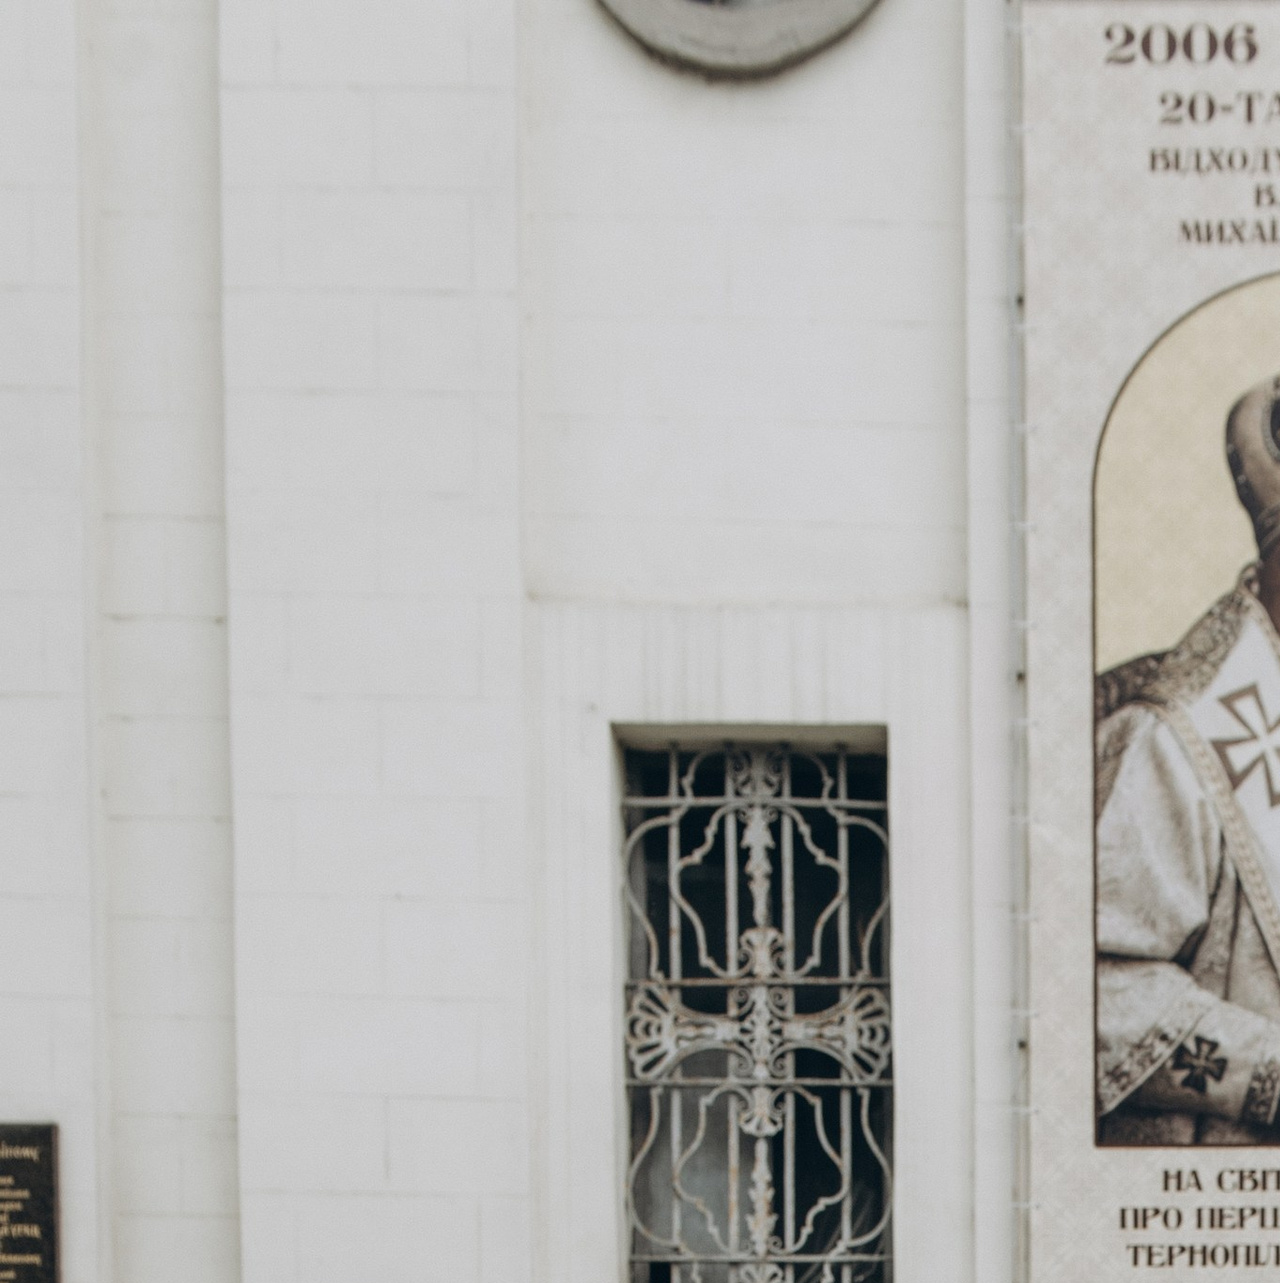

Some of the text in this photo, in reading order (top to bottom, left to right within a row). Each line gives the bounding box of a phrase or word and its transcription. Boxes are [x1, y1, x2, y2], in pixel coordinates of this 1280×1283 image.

[1102, 22, 1260, 67] 2006
[1161, 1167, 1204, 1194] НА
[1118, 1206, 1184, 1232] ПРО
